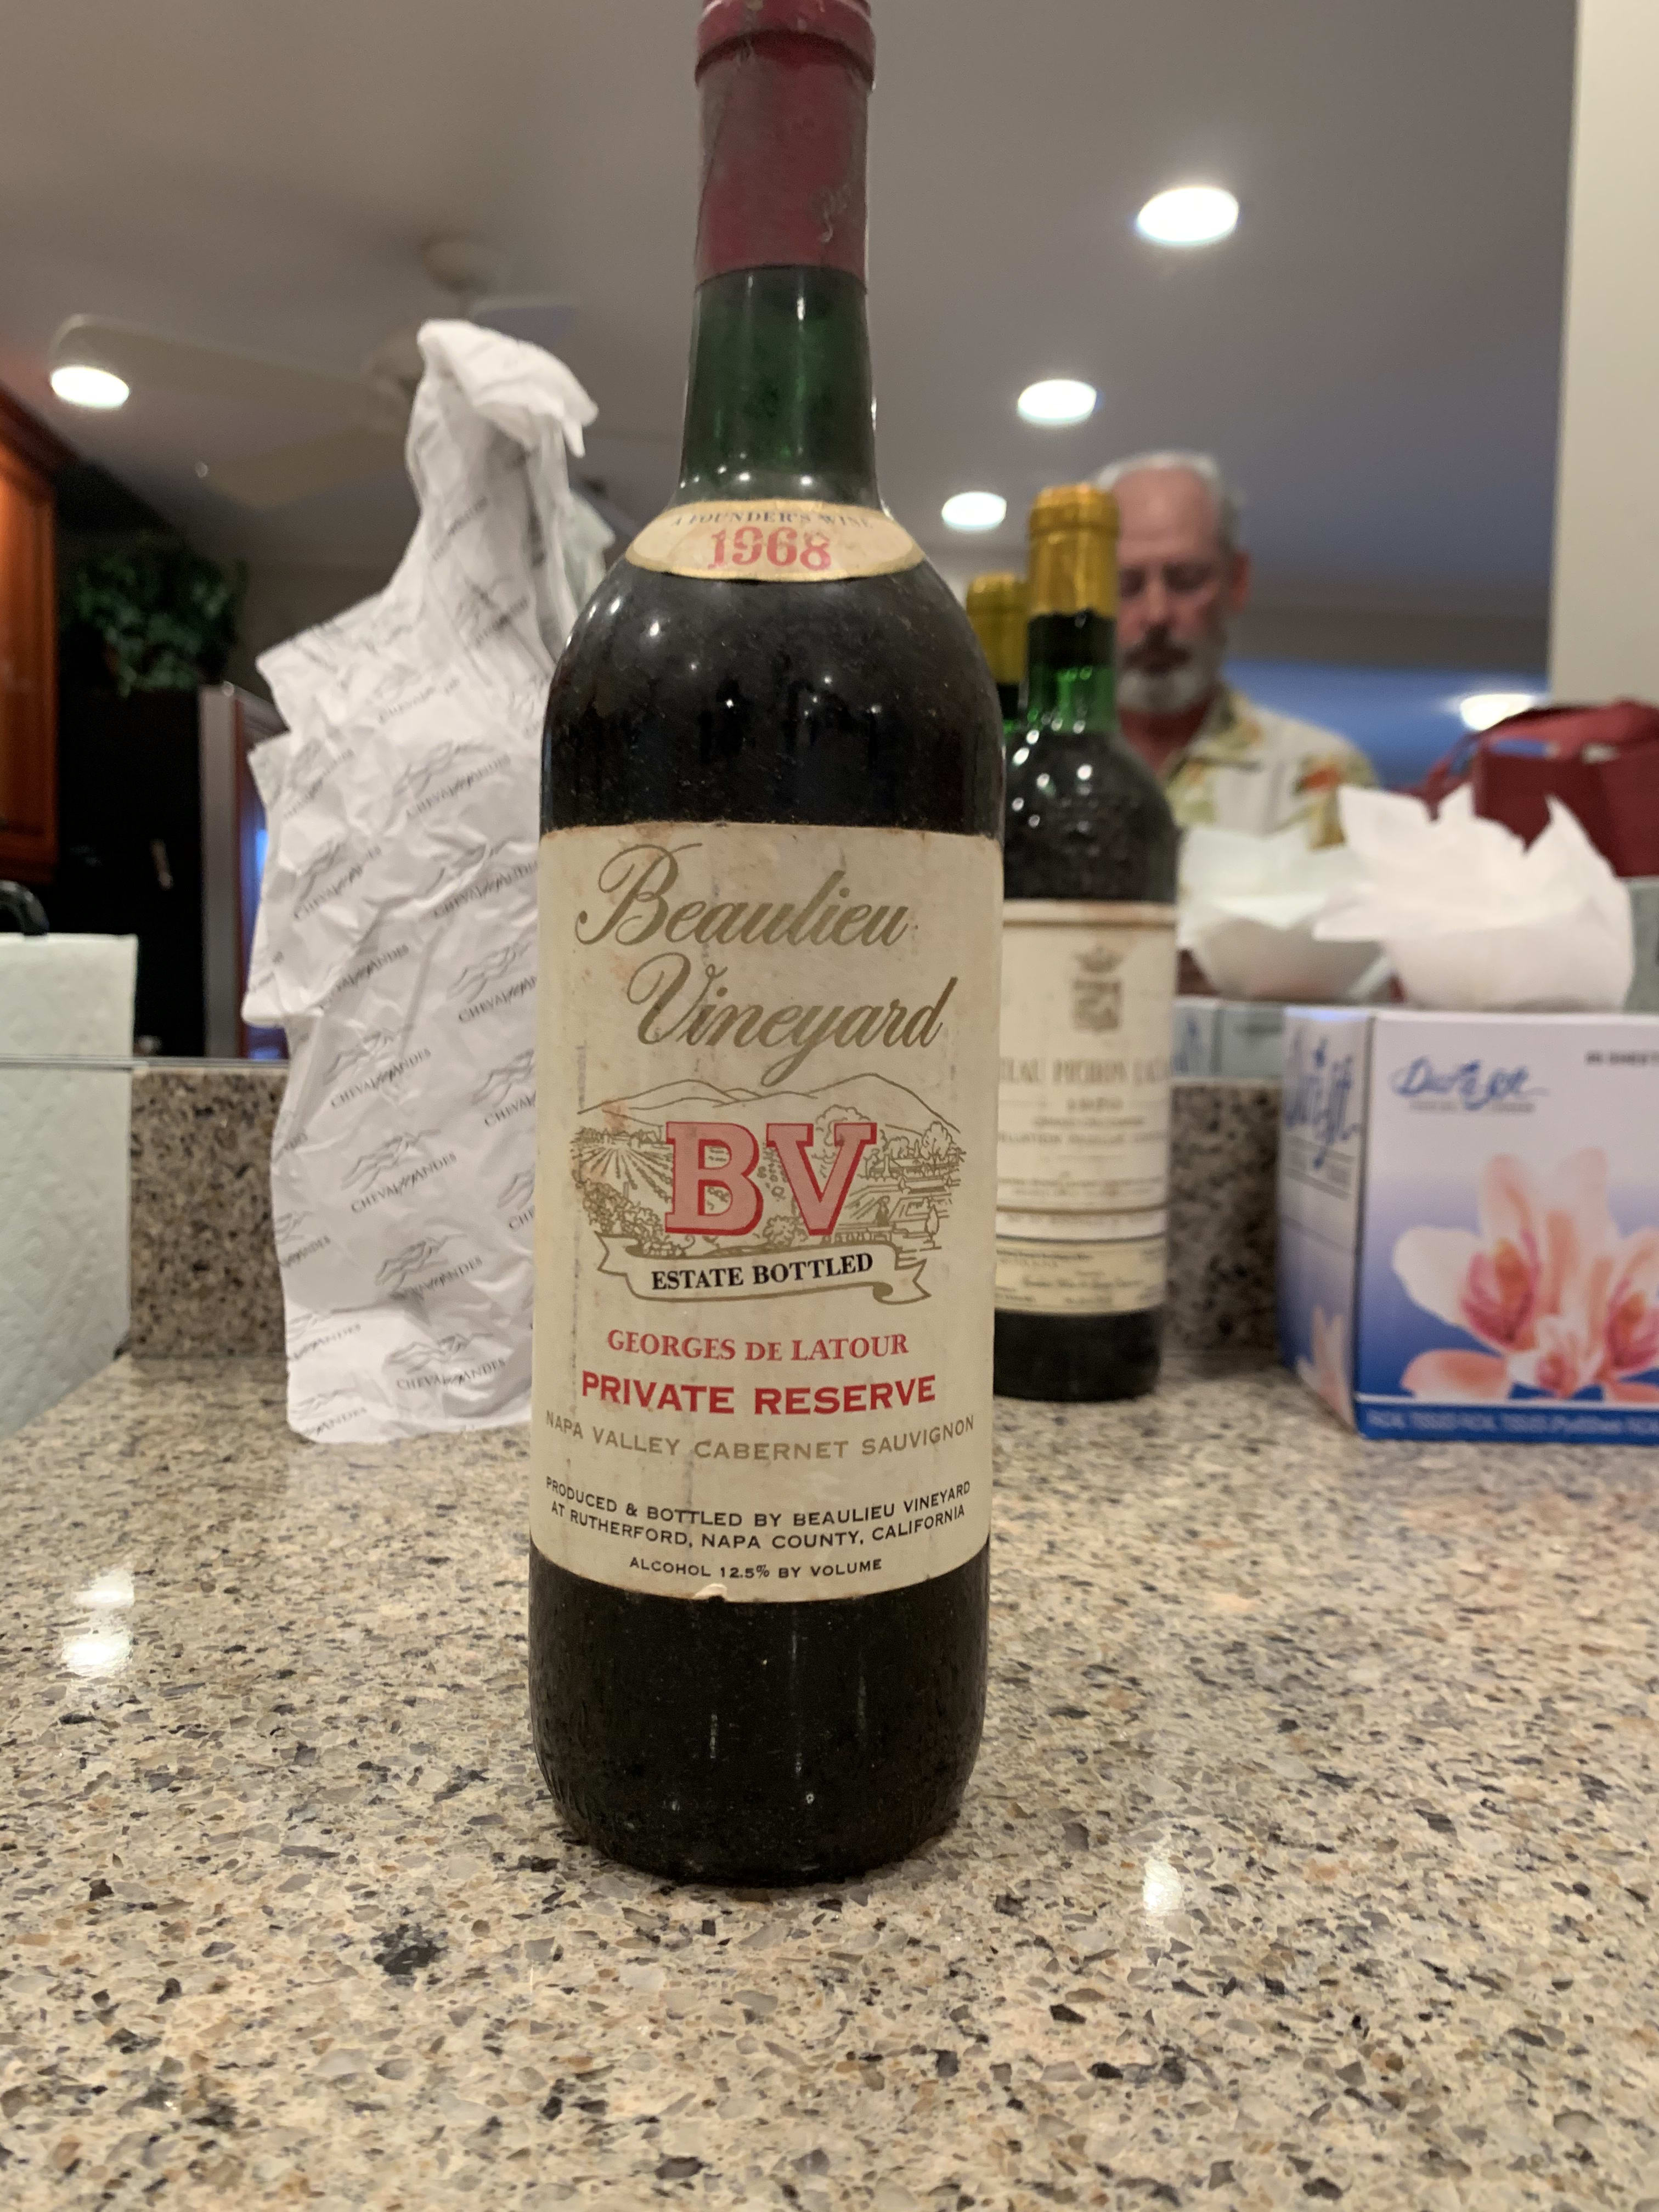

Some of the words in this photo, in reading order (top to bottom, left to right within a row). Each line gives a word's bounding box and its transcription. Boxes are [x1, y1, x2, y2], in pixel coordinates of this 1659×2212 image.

[688, 511, 811, 526] FOUNDER'S
[708, 526, 832, 571] 1968
[575, 843, 910, 947] Beaulieu
[627, 952, 958, 1087] Vineyard
[665, 1122, 877, 1236] BV
[651, 1267, 743, 1291] ESTATE
[753, 1252, 874, 1285] BOTTLED
[607, 1329, 736, 1360] GEORGES
[745, 1342, 782, 1361] DE
[791, 1334, 909, 1361] LATOUR
[582, 1369, 735, 1414] PRIVATE
[754, 1374, 935, 1415] RESERVE
[546, 1410, 584, 1440] NAPA
[592, 1426, 680, 1456] VALLEY
[694, 1439, 849, 1461] CABERNET
[862, 1415, 974, 1455] SAUVIGNON
[546, 1476, 617, 1513] PRODUCED
[625, 1503, 638, 1517] &
[647, 1505, 743, 1527] BOTTLED
[754, 1513, 782, 1527] BY
[793, 1503, 895, 1526] BEAULIEU
[904, 1480, 970, 1514] VINEYARD
[551, 1500, 566, 1517] AT
[570, 1509, 693, 1548] RUTHERFORD,
[702, 1533, 761, 1549] NAPA
[772, 1530, 864, 1549] COUNTY,
[872, 1504, 965, 1541] CALIFORNIA
[629, 1556, 712, 1577] ALCOHOL
[720, 1564, 770, 1579] 12.5%
[778, 1566, 801, 1579] BY
[811, 1558, 882, 1577] VOLUME
